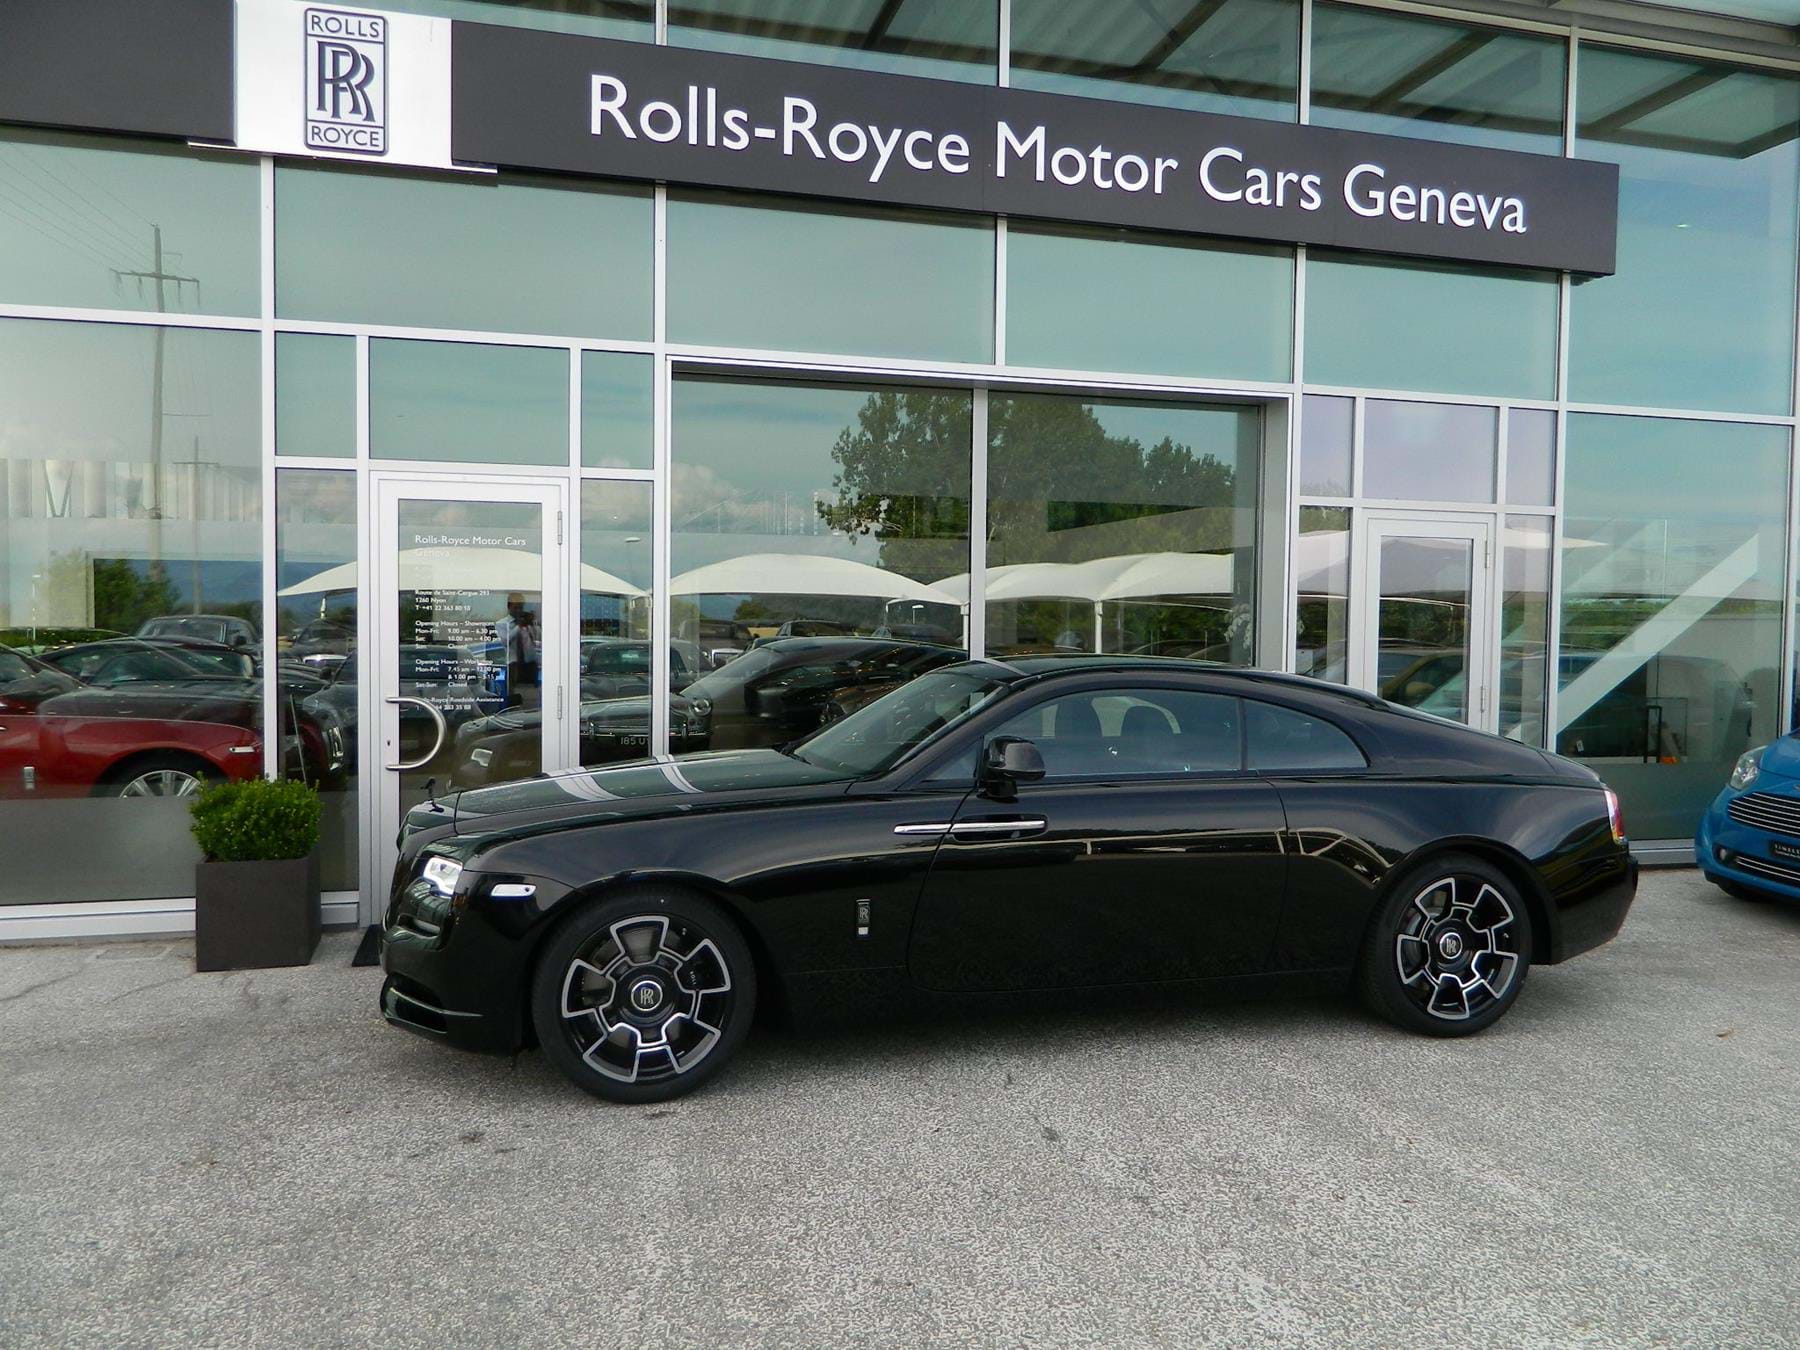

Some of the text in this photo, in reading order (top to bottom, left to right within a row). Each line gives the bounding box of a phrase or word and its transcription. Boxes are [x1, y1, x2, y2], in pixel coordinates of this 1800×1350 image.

[311, 15, 380, 38] ROLLS
[311, 125, 380, 148] ROYCE
[589, 74, 1528, 235] Rolls-Royce Motor Cars Geneva
[415, 535, 527, 546] Rolls-Royce Motor Cars
[415, 620, 439, 628] Opening
[415, 658, 439, 666] Opening
